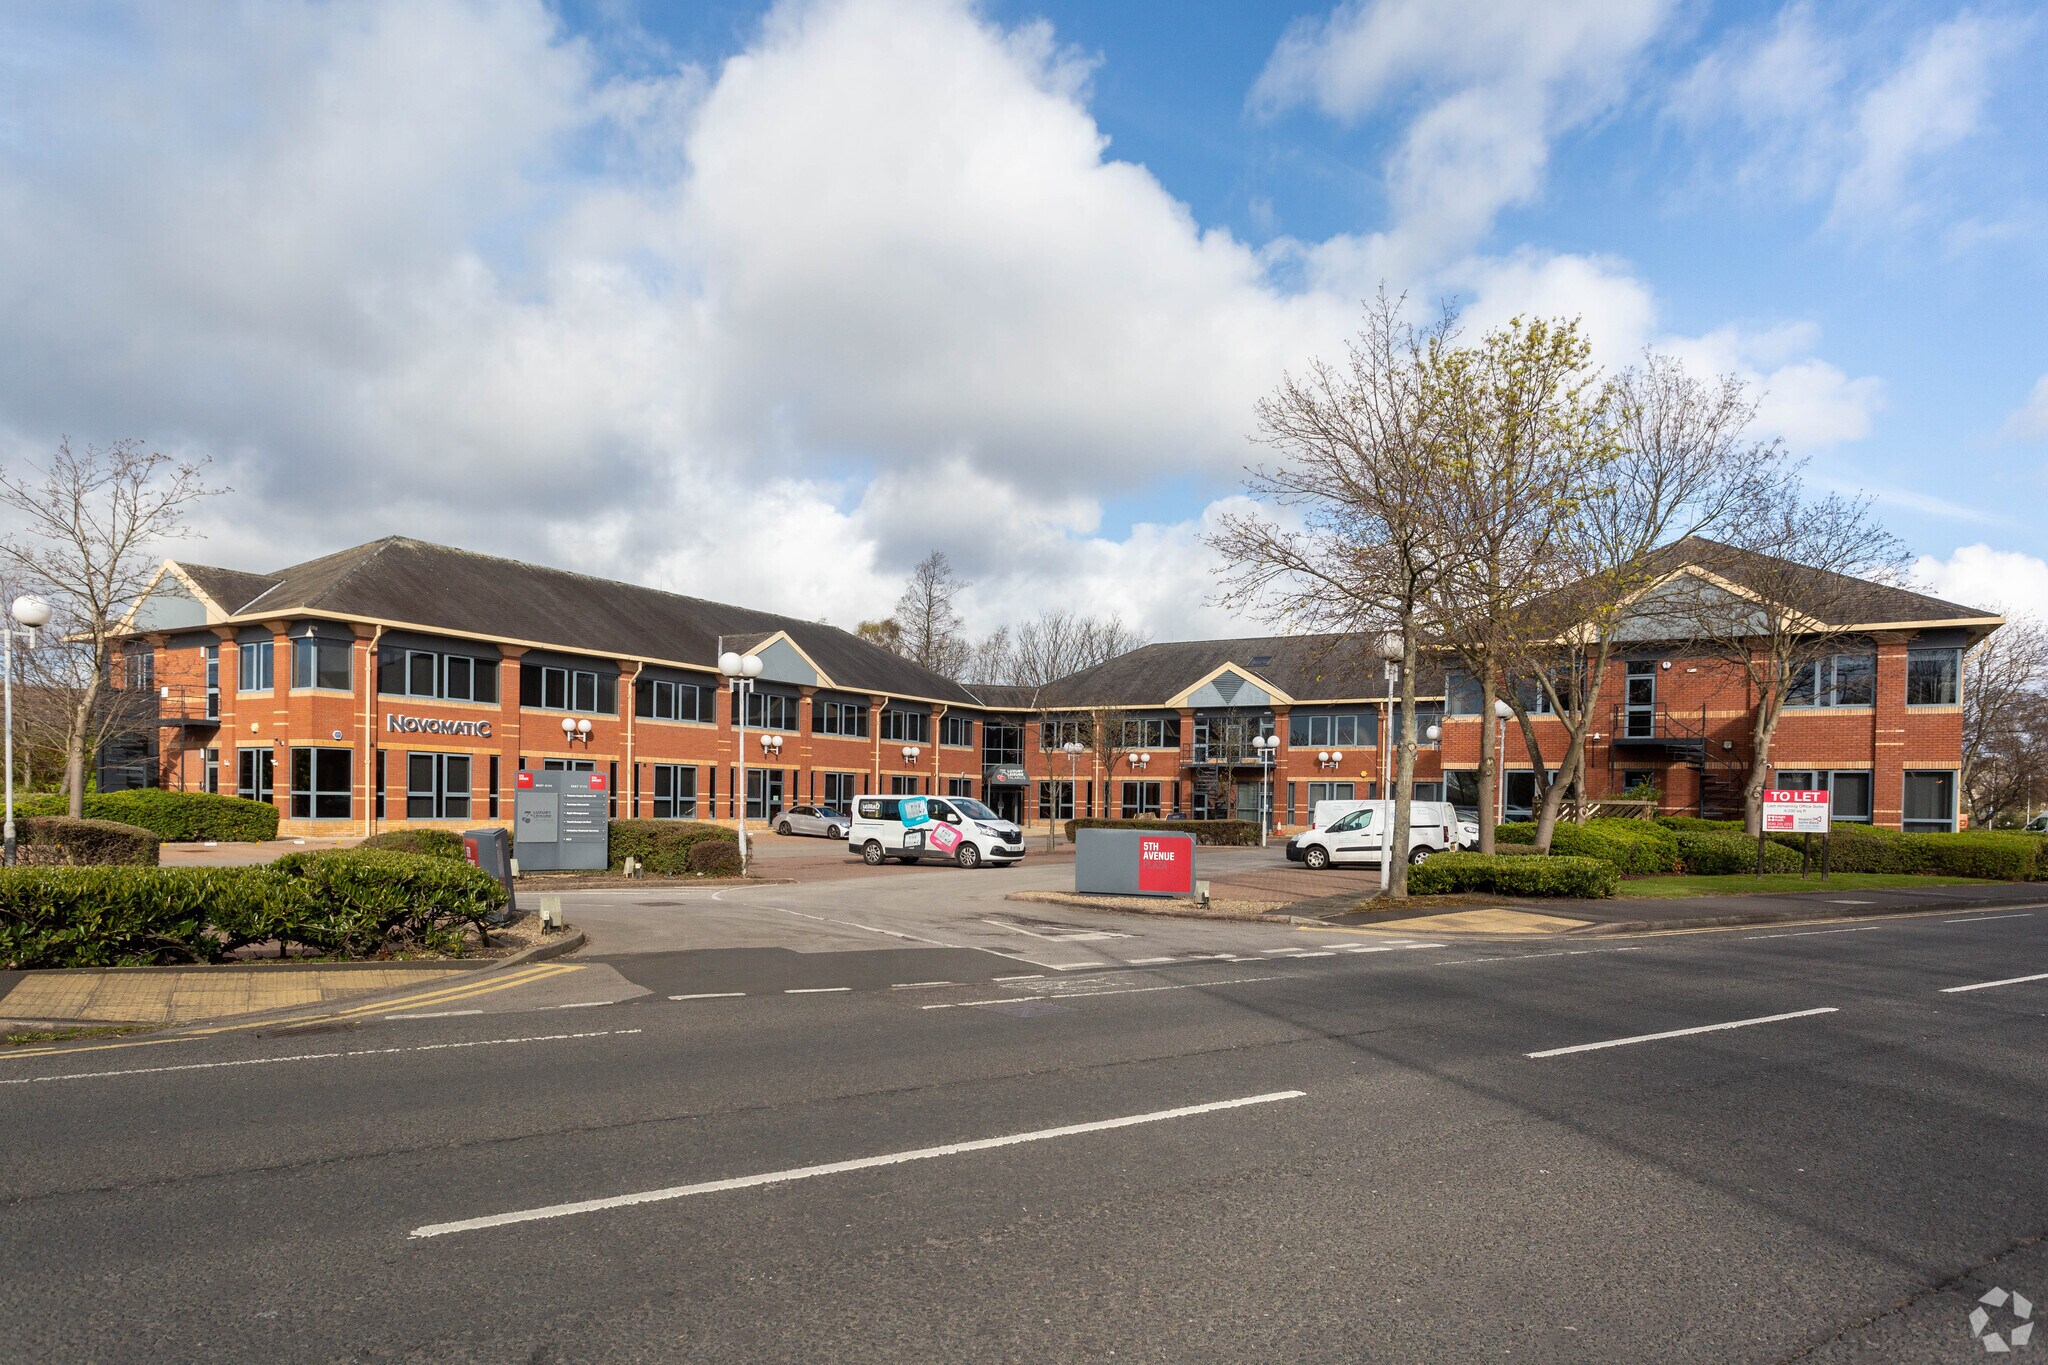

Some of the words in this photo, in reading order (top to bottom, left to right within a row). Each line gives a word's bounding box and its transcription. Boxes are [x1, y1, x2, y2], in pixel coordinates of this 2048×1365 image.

[387, 713, 492, 738] NOVOMATIC
[1771, 791, 1790, 802] TO
[1794, 791, 1820, 802] LET
[1143, 842, 1159, 851] 5TH
[1143, 852, 1175, 861] AVENUE
